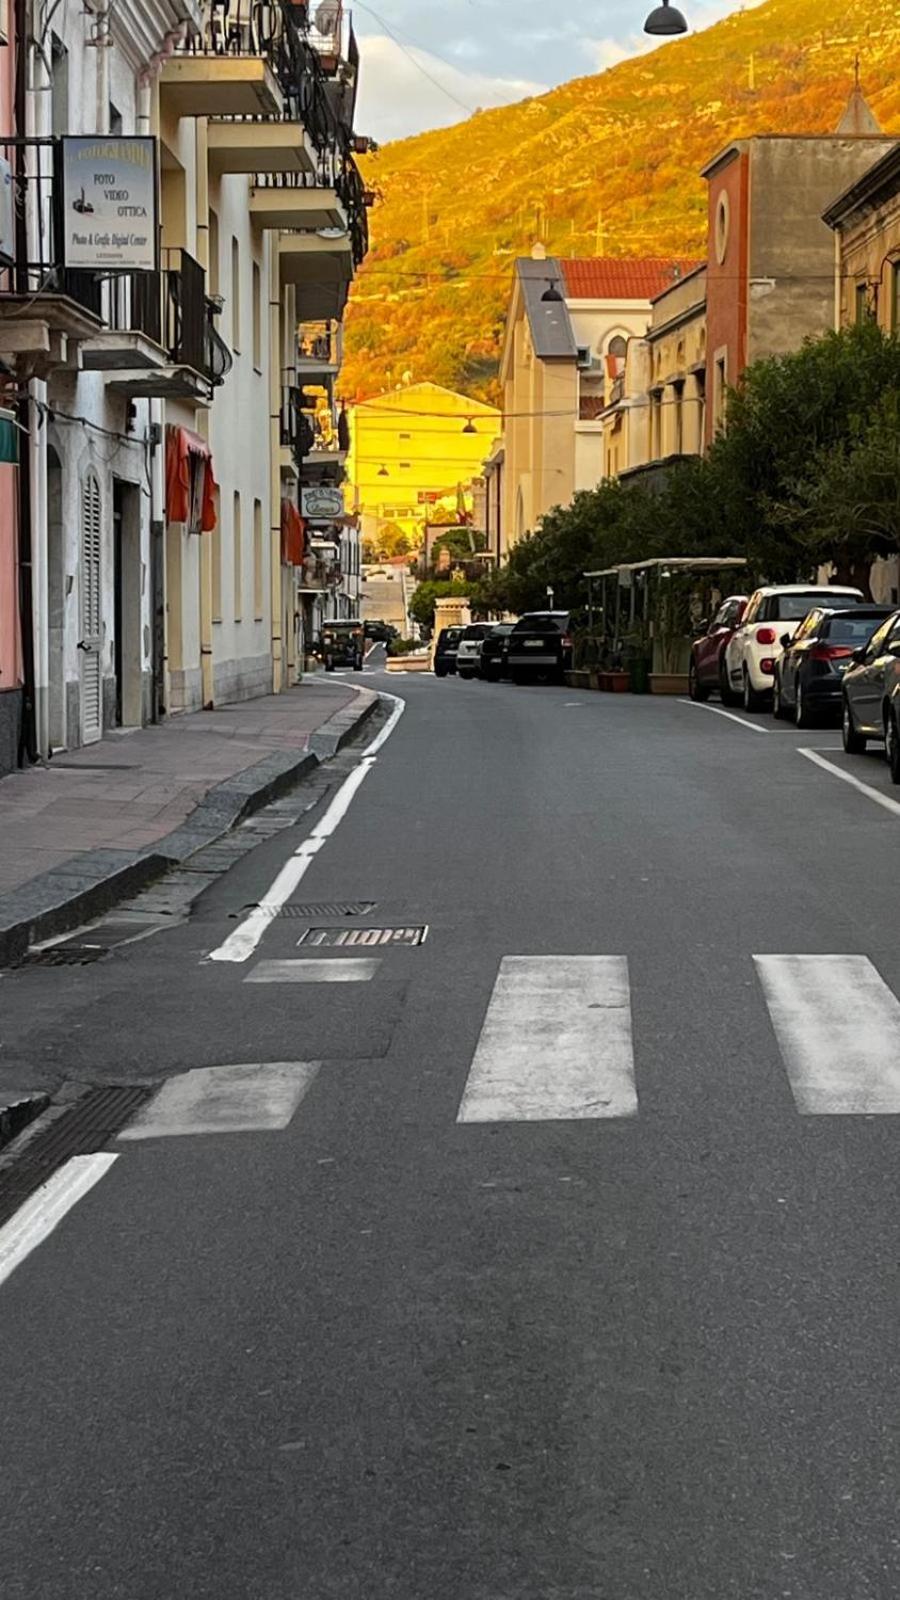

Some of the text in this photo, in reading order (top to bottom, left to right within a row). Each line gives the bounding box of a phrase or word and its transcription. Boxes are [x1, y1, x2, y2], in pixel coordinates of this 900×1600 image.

[93, 174, 115, 185] FOTO
[104, 190, 129, 201] VIDEO
[117, 206, 147, 217] OTTICA
